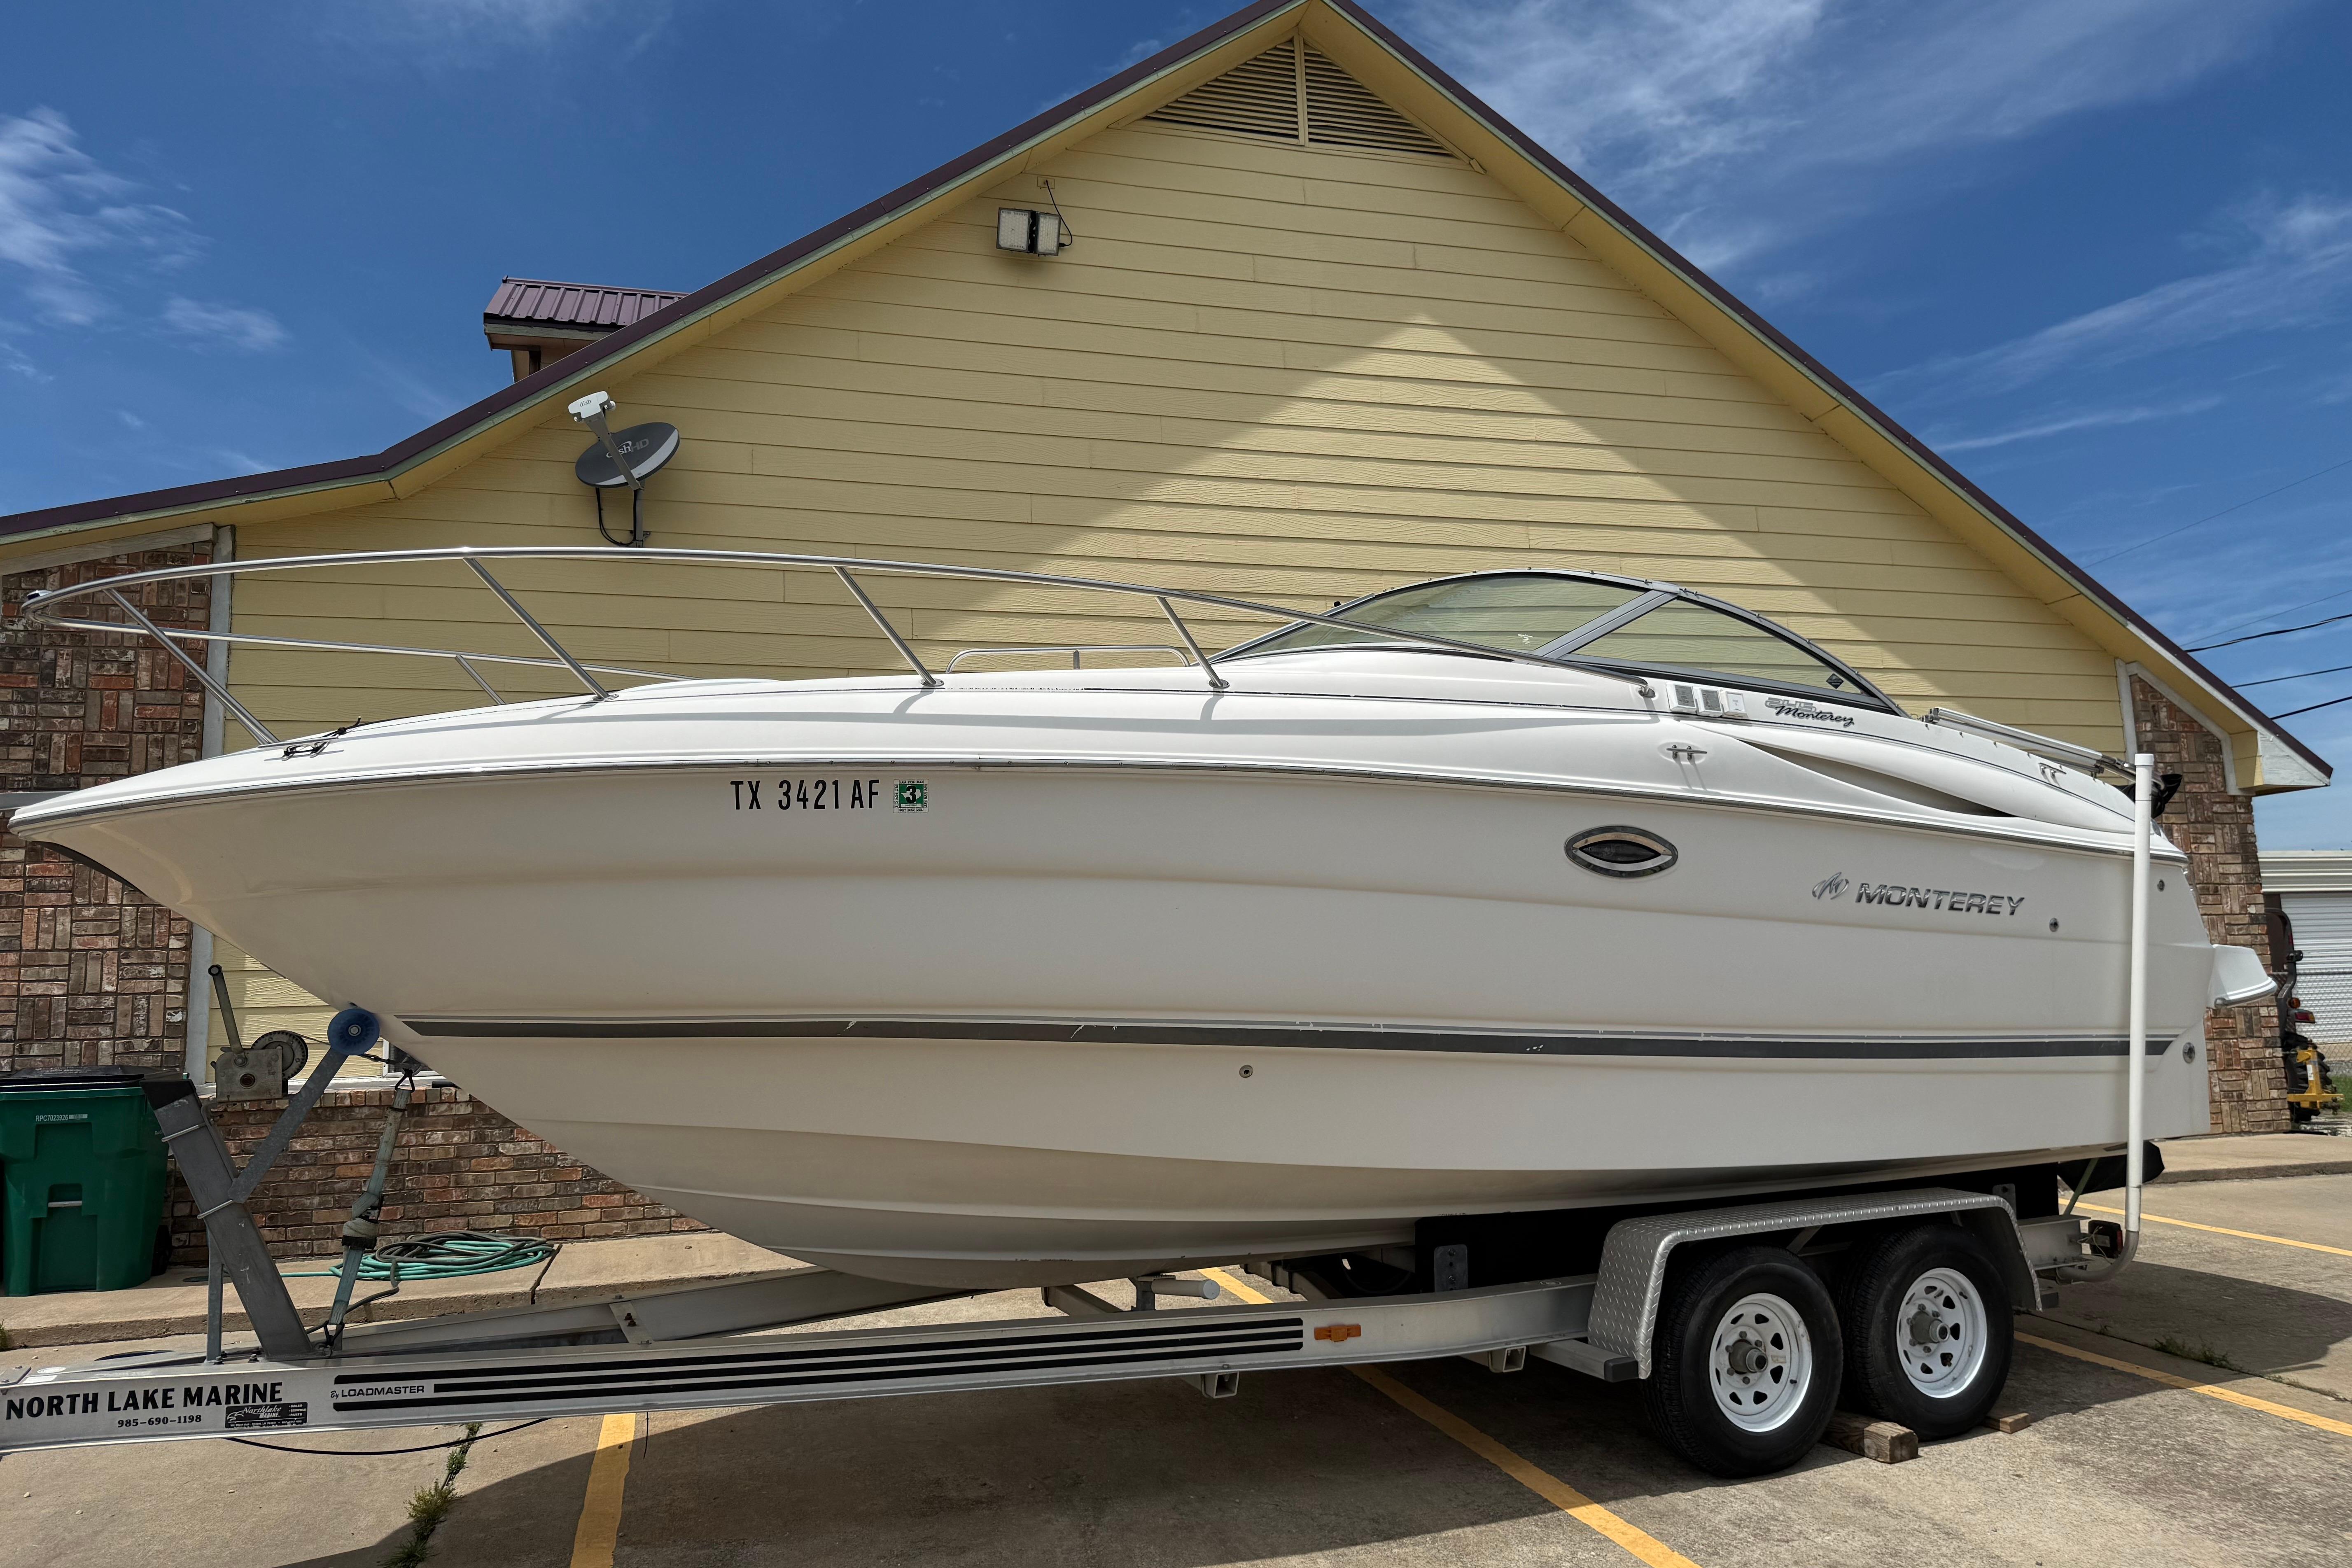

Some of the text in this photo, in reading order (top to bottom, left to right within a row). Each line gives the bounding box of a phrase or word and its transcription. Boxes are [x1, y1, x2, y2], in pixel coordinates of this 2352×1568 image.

[1775, 705, 1855, 728] Monterey
[730, 779, 880, 810] TX 3421 AF
[906, 786, 916, 804] 3
[1855, 882, 2025, 916] MONTEREY
[6, 1382, 282, 1420] NORTH LAKE MARINE
[331, 1385, 425, 1399] By LOADMASTER
[118, 1415, 202, 1428] 985-690-1198
